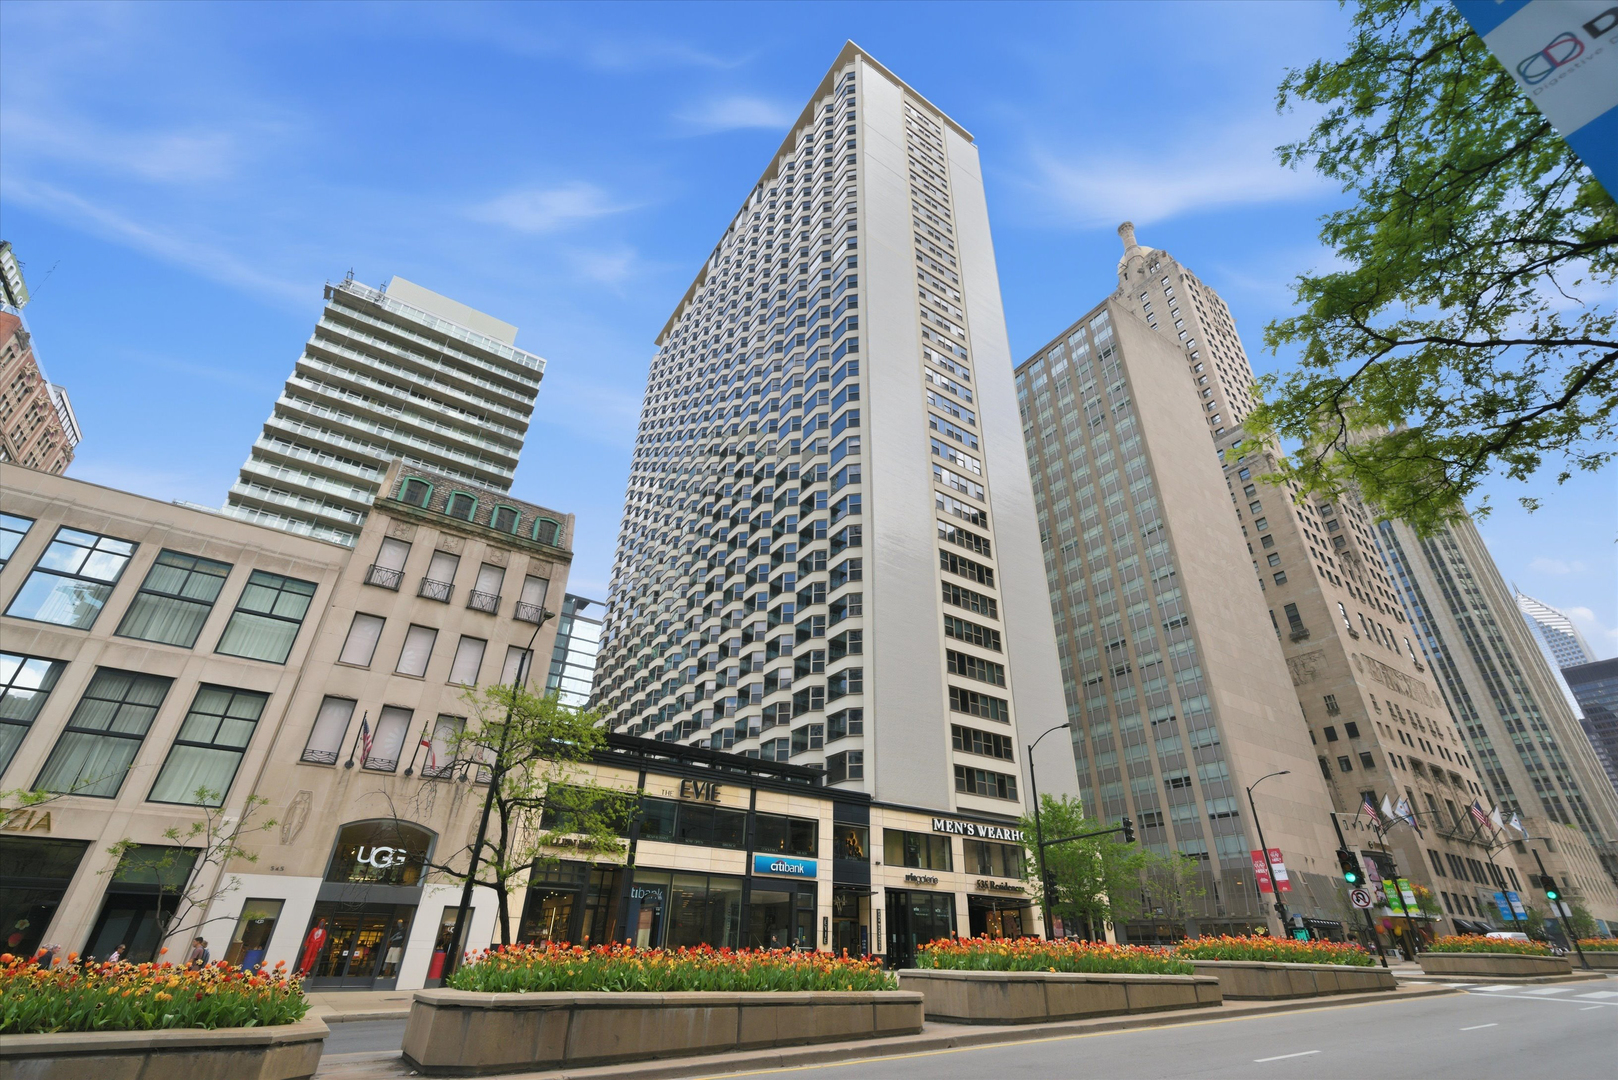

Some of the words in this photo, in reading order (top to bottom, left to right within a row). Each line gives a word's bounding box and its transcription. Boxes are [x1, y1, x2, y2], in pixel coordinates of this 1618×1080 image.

[1532, 47, 1603, 96] Digestive
[680, 778, 722, 802] EVIE
[933, 818, 975, 836] MEN'S
[357, 846, 407, 868] UGG
[770, 861, 804, 874] citibank
